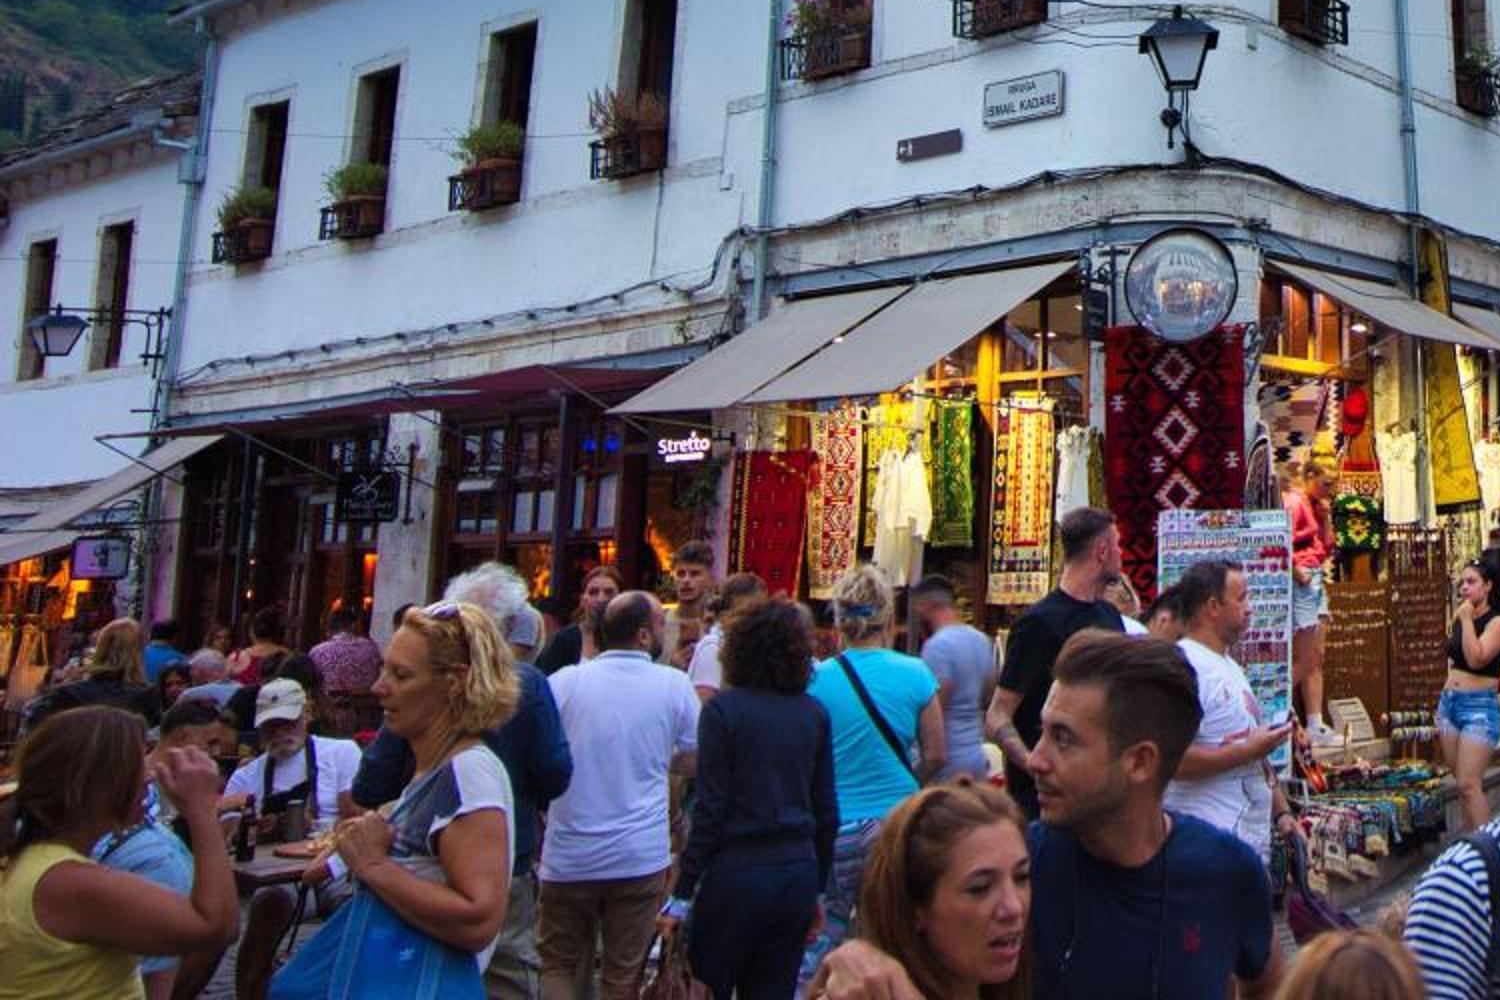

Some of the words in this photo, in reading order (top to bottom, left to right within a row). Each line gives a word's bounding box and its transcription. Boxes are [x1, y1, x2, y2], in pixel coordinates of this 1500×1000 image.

[1008, 80, 1037, 94] RRUGA
[986, 102, 1016, 117] ISMAIL
[1020, 93, 1057, 110] KADARE
[657, 437, 711, 455] Stretto
